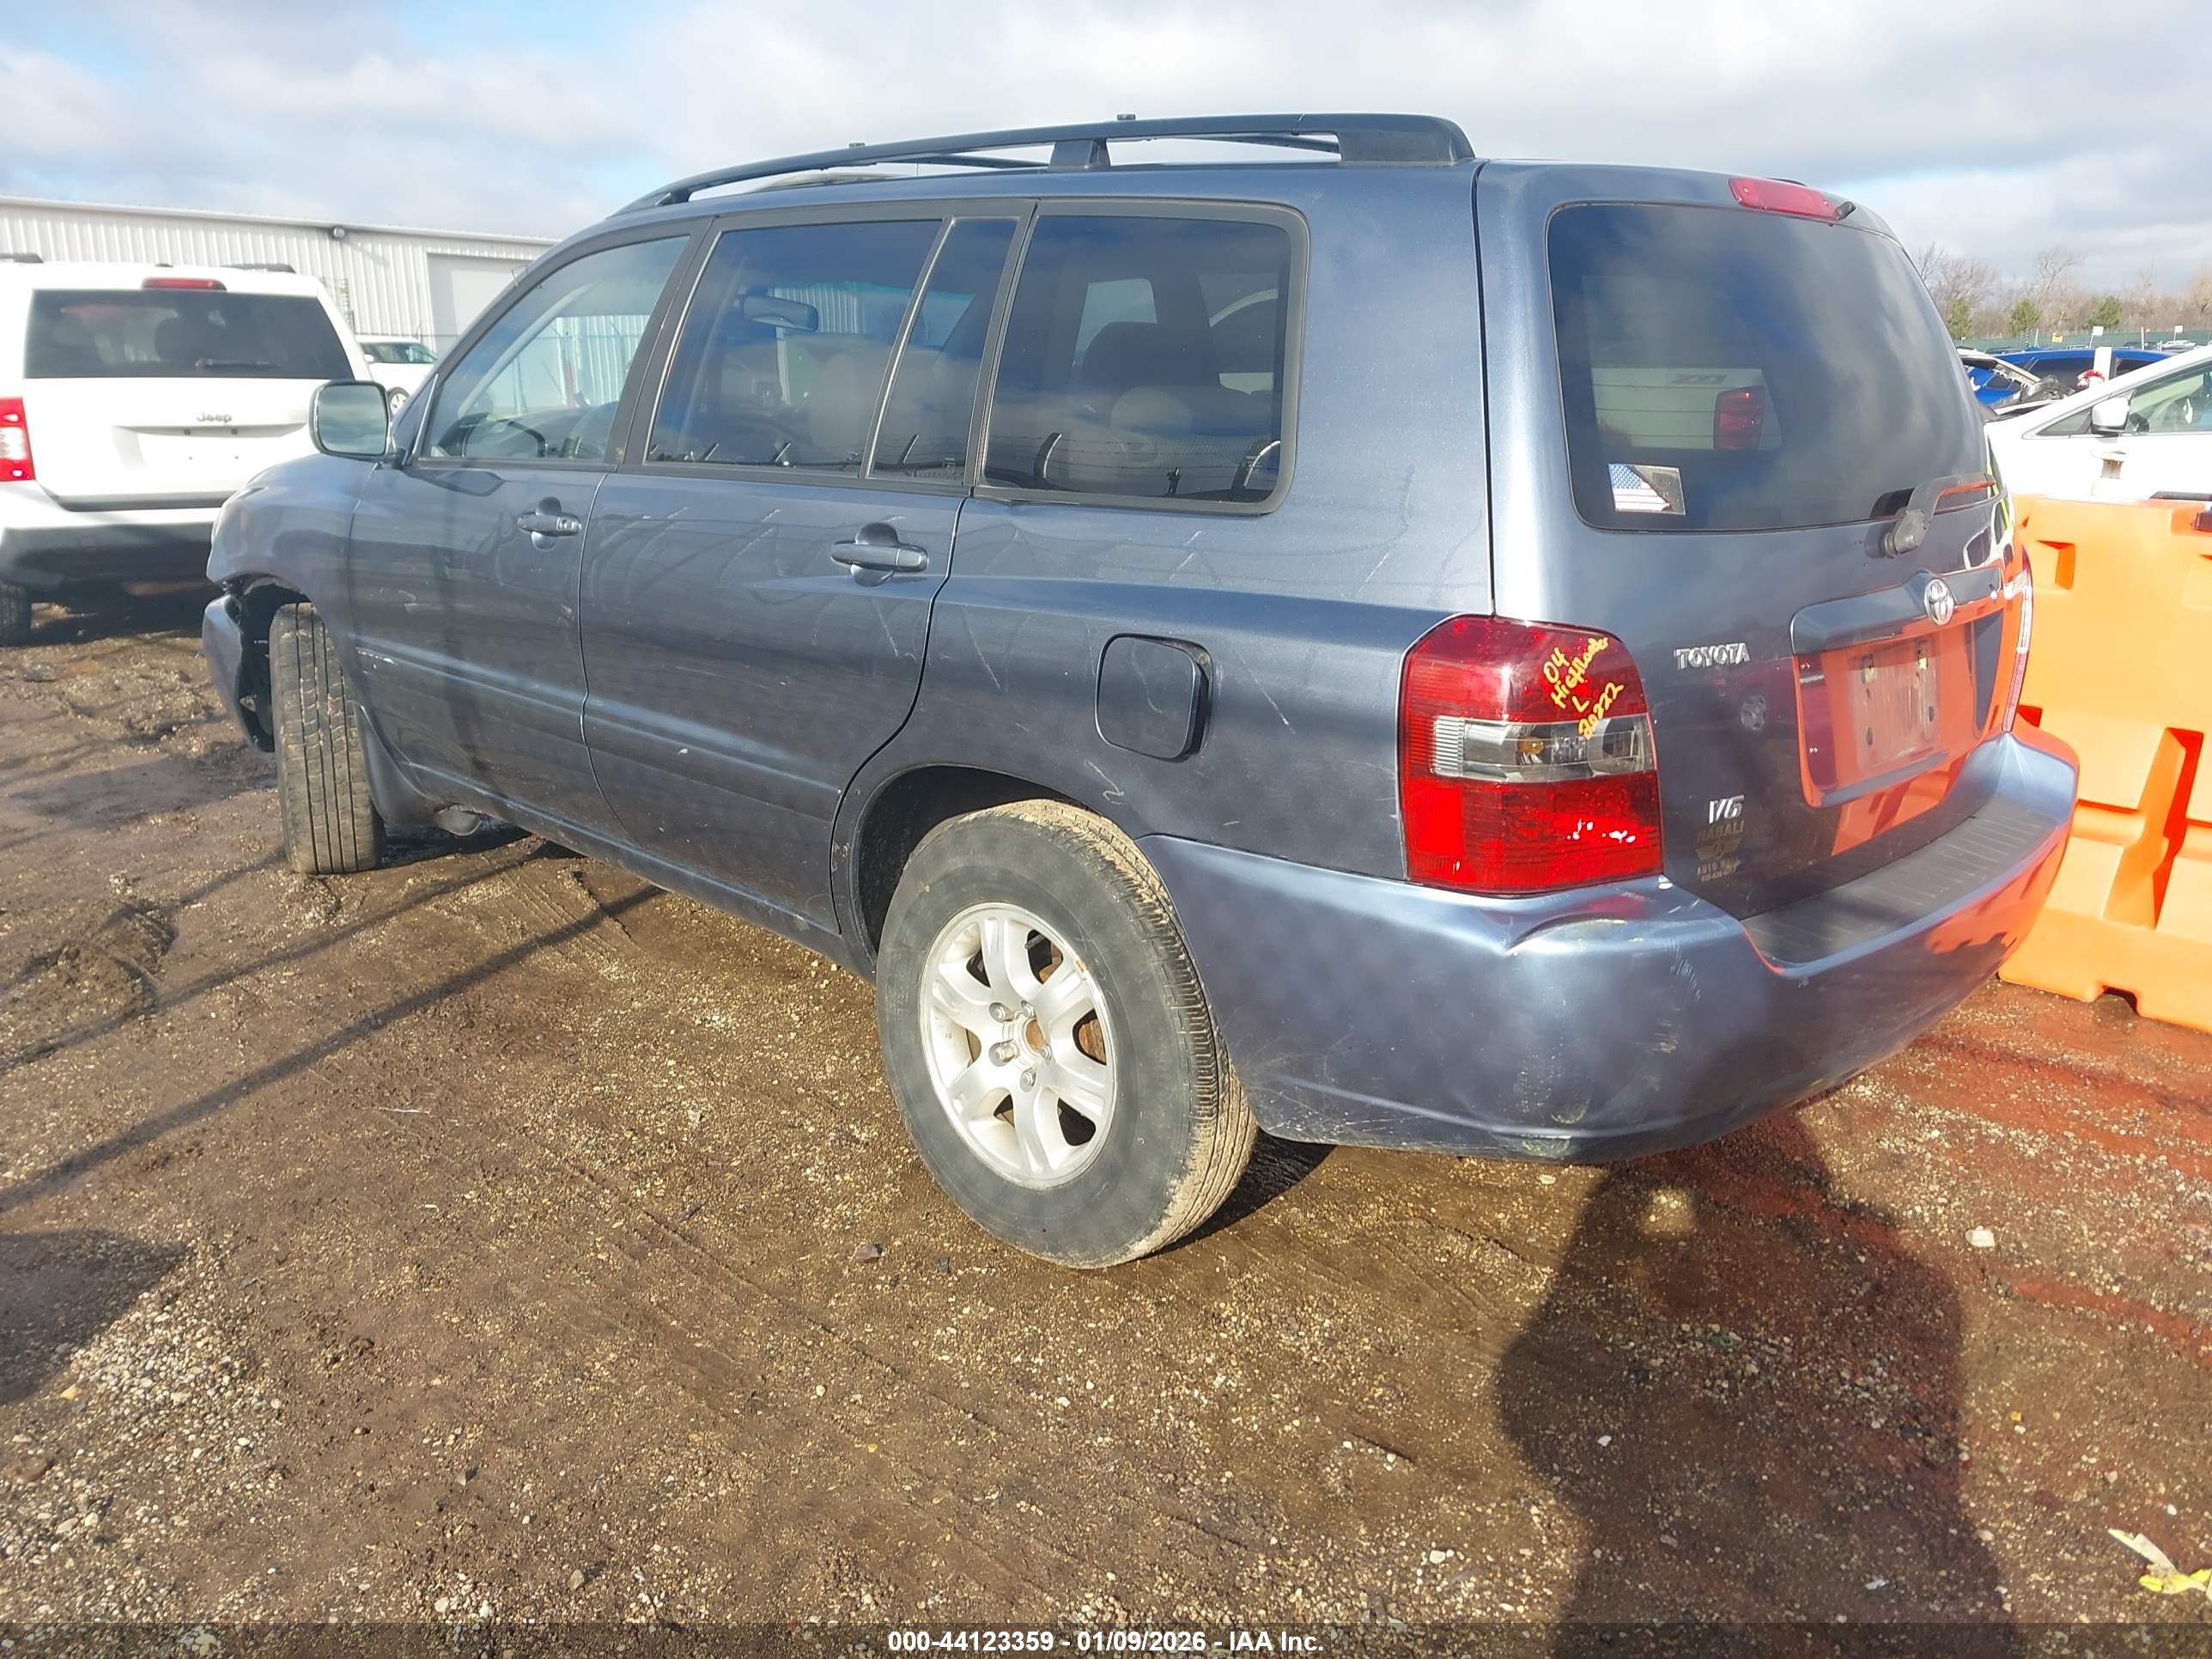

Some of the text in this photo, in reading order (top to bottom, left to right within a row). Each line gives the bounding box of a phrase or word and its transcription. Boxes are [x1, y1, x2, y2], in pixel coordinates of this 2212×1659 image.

[196, 411, 233, 423] Jeep
[1542, 647, 1571, 684] 04
[1674, 642, 1751, 670] TOYOTA
[1571, 695, 1590, 714] L
[1708, 794, 1746, 824] V6
